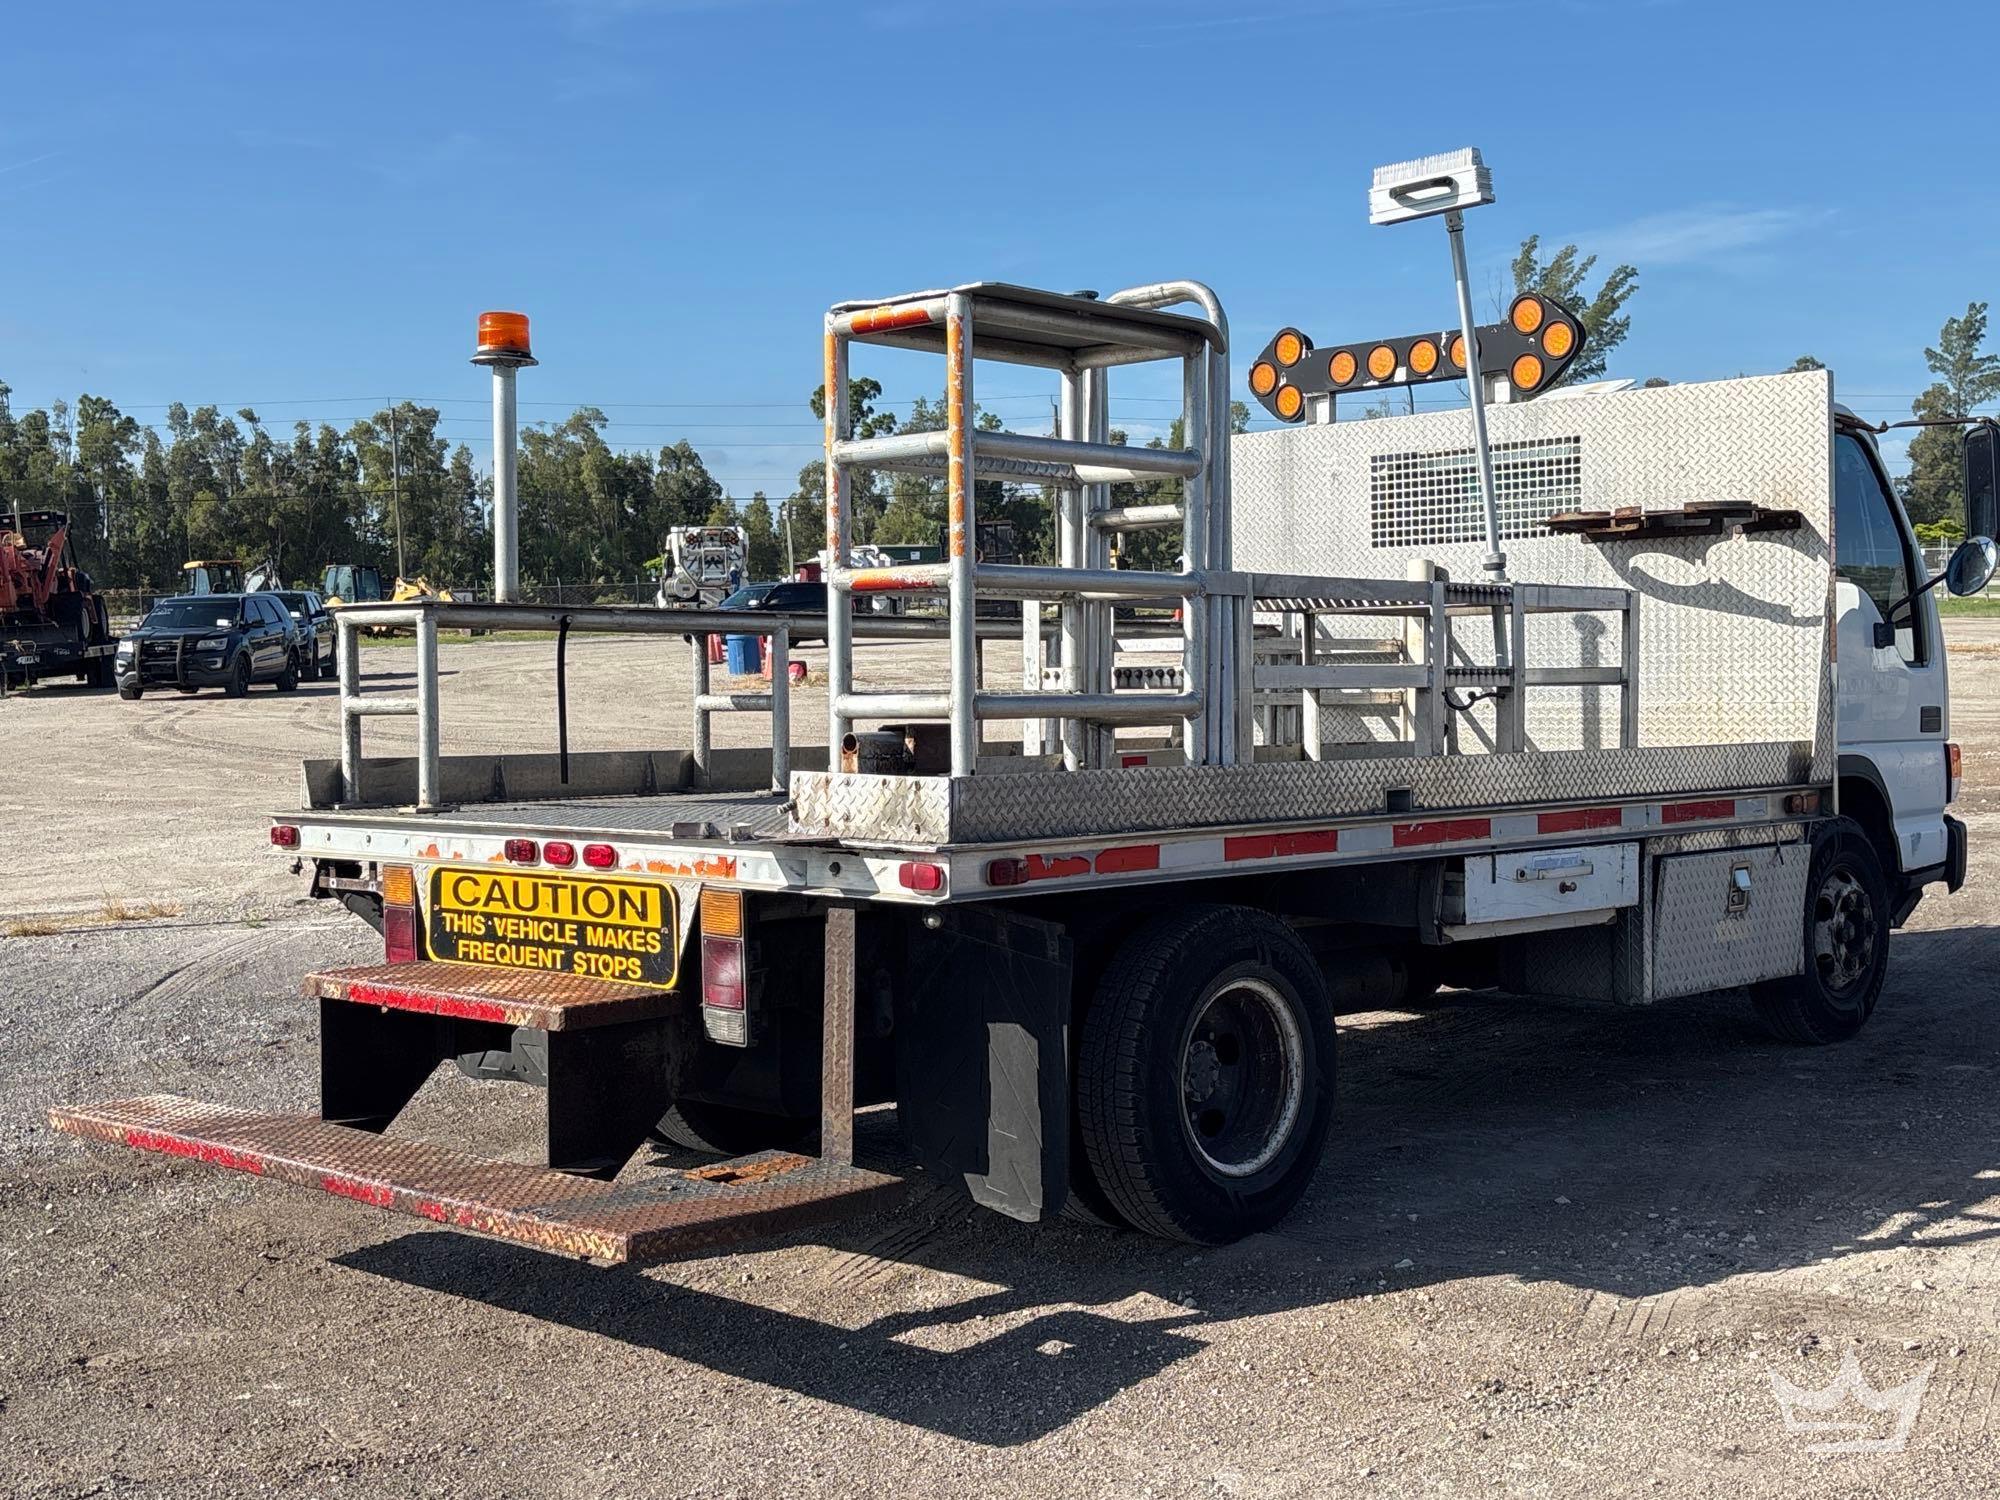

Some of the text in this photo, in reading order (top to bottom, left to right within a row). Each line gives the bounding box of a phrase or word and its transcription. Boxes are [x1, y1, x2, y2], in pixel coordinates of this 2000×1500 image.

[452, 875, 649, 922] CAUTION
[442, 912, 661, 954] THIS VEHICLE MAKES
[458, 939, 642, 980] FREQUENT STOPS
